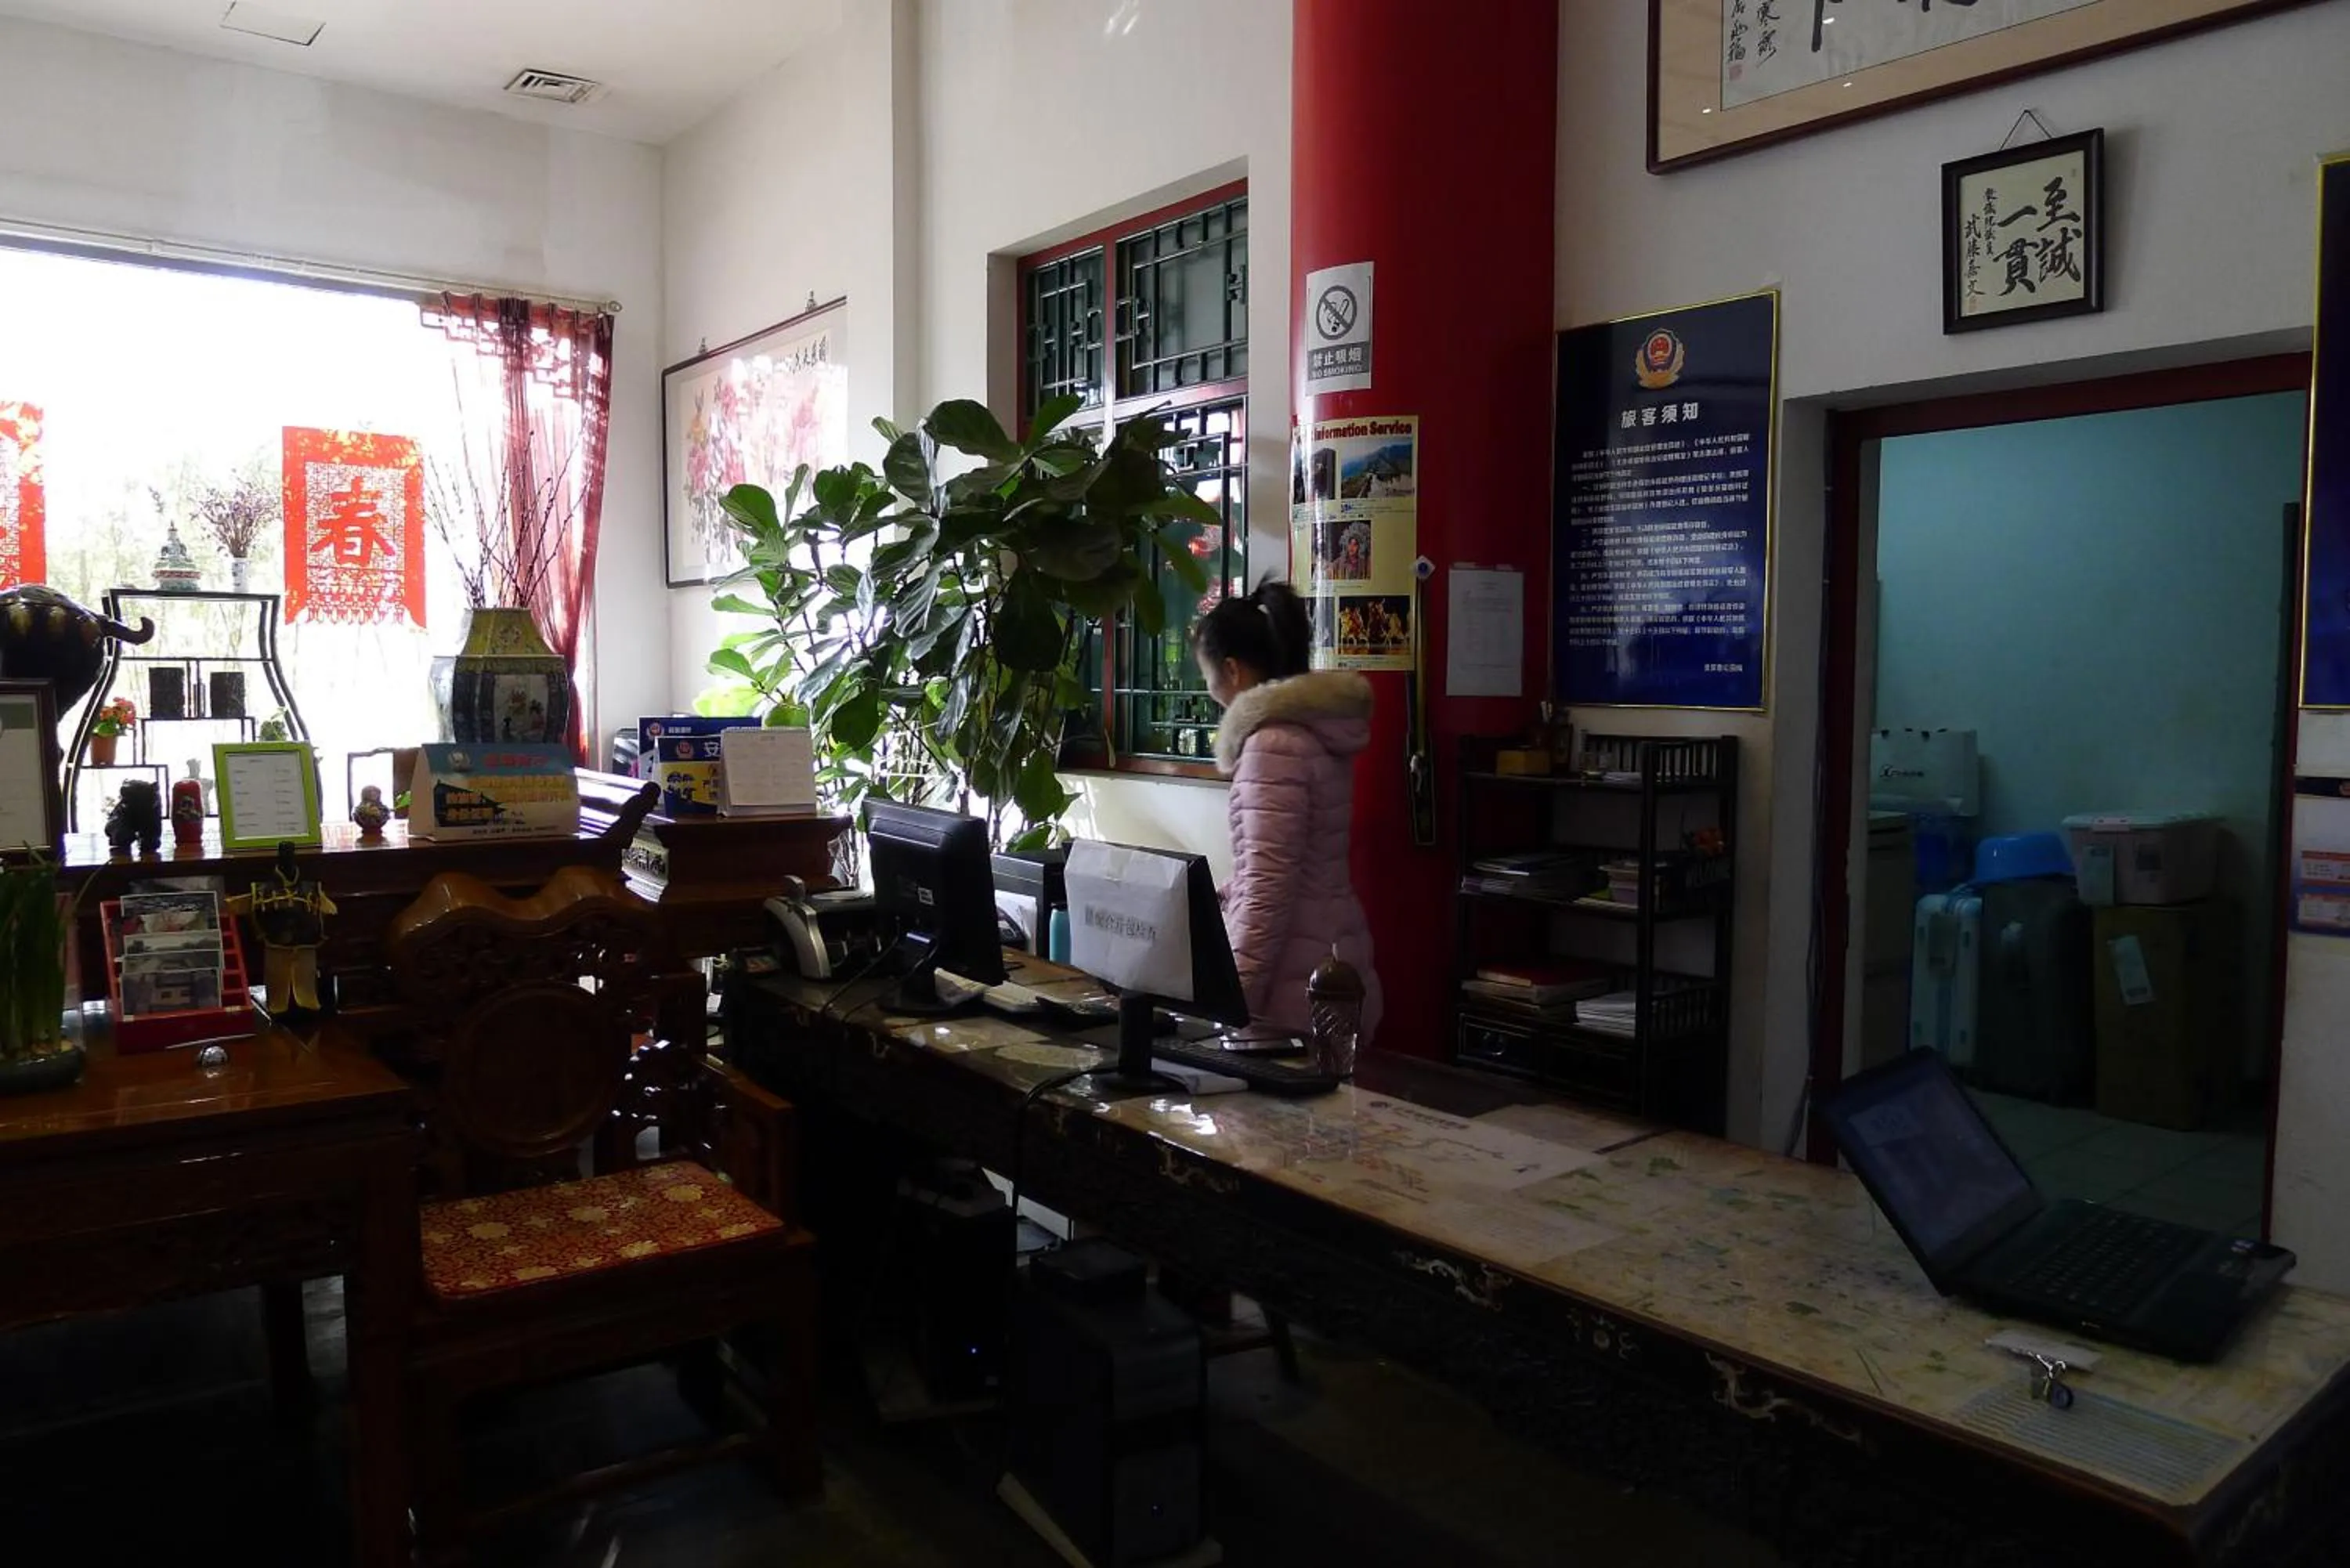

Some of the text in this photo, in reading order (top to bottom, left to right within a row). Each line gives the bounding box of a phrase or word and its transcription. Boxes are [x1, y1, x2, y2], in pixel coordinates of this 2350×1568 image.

[1313, 347, 1362, 367] 禁止吸烟
[1312, 364, 1362, 378] NO SMOKING
[1621, 402, 1698, 428] 旅客须知
[1314, 421, 1412, 441] Information Service
[310, 475, 396, 565] 春
